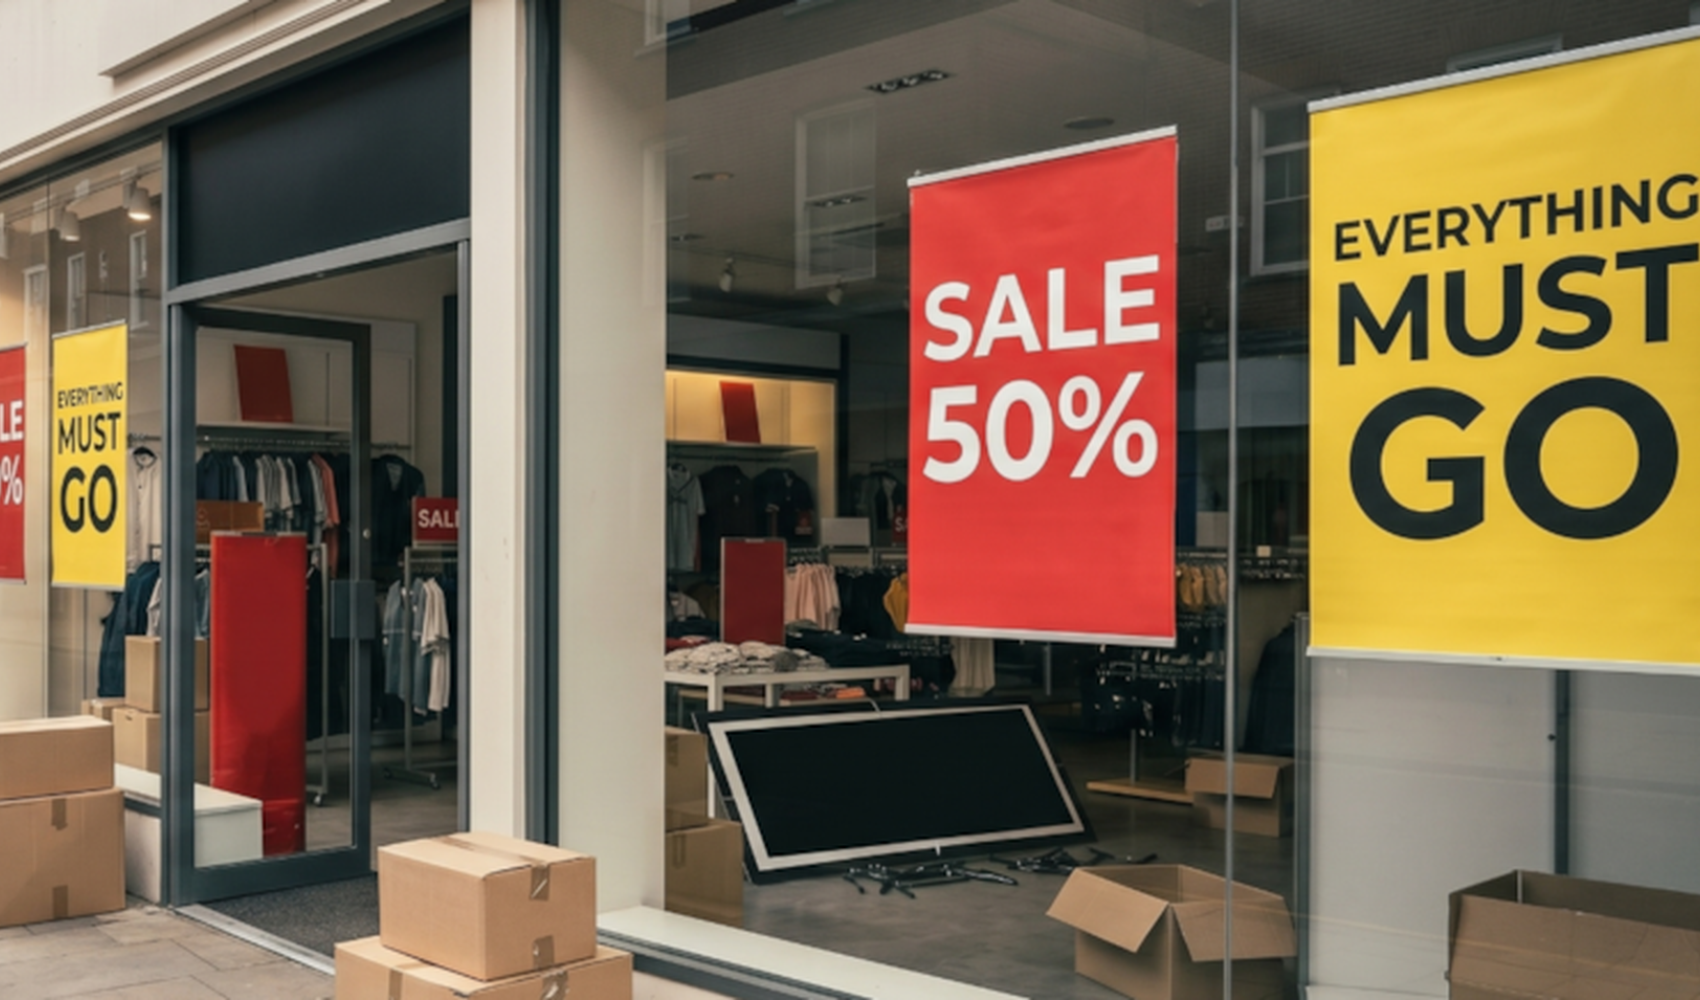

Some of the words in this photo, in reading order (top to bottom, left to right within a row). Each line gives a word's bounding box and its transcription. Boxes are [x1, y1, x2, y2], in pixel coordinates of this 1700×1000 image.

[1334, 173, 1700, 262] EVERYTHING
[923, 254, 1161, 363] SALE
[1337, 242, 1700, 367] MUST
[57, 381, 123, 409] EVERYTHING
[58, 411, 121, 455] MUST
[922, 370, 1159, 484] 50%
[60, 464, 118, 533] GO
[1348, 375, 1681, 541] GO
